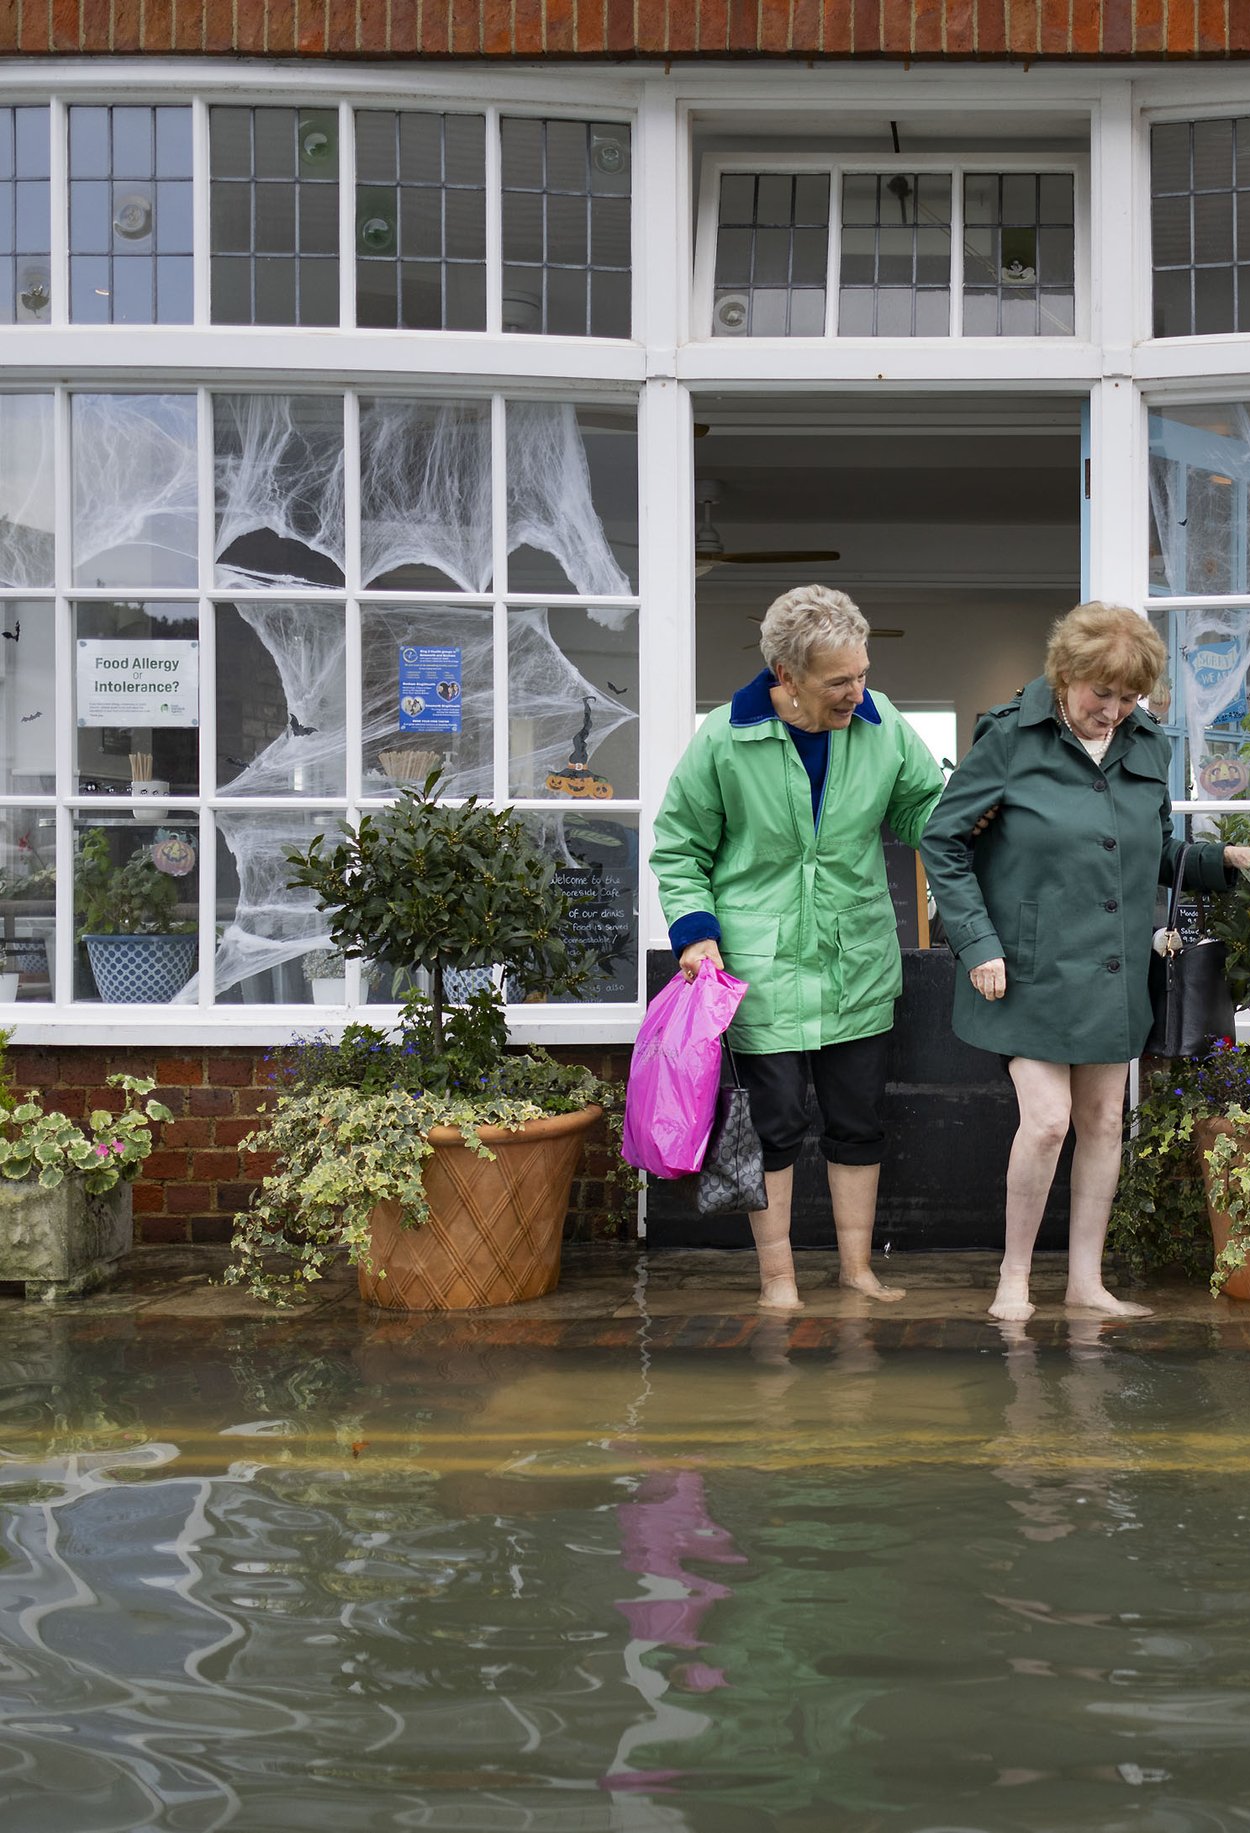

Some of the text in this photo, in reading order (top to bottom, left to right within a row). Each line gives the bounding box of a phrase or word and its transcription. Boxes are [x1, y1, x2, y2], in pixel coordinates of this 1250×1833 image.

[95, 657, 179, 672] Food Allergy
[94, 681, 180, 693] Intolerance?
[568, 908, 579, 918] of
